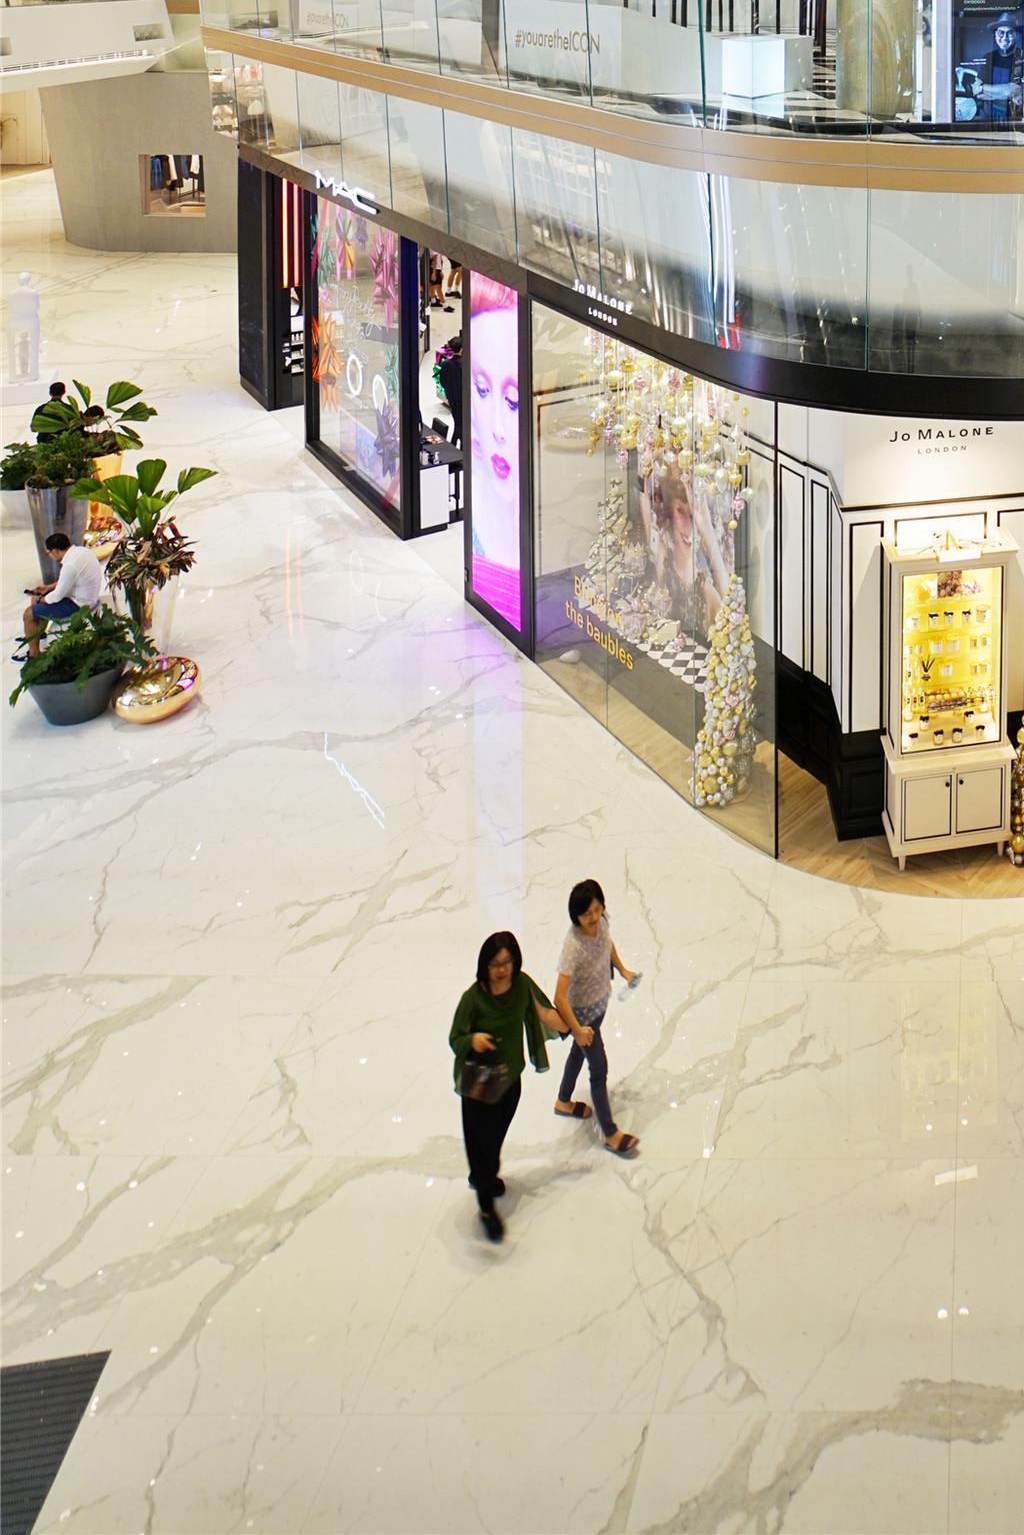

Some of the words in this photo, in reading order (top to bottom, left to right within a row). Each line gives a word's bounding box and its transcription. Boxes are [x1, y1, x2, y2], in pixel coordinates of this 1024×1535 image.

[917, 446, 967, 455] LONDON
[565, 599, 584, 628] the
[586, 615, 634, 671] baubles
